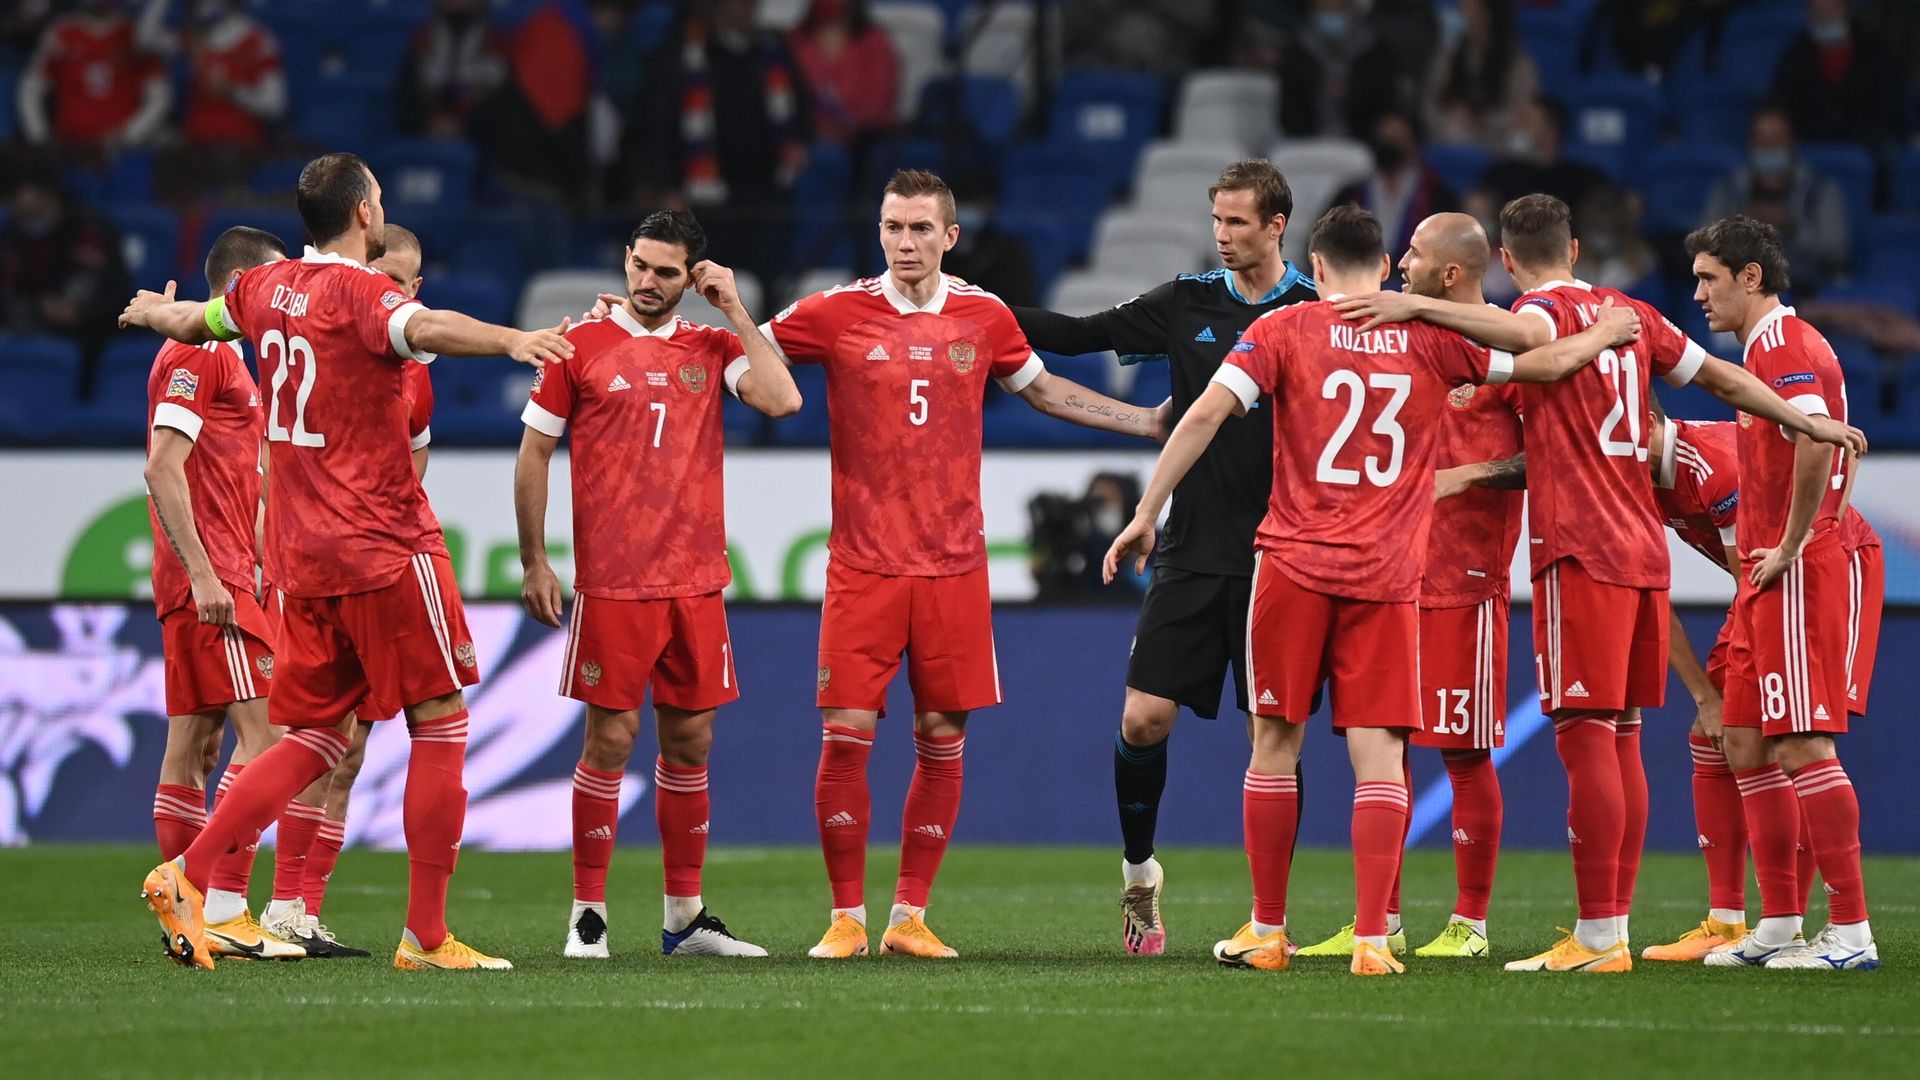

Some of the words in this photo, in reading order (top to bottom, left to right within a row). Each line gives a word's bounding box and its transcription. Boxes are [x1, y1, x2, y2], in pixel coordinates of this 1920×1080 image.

[1330, 324, 1408, 354] KUZIAEV
[260, 329, 326, 447] 22
[1784, 373, 1814, 384] RESPECT
[650, 402, 666, 448] 7
[909, 379, 930, 426] 5
[1599, 348, 1648, 462] 21
[1316, 369, 1412, 488] 23
[1718, 491, 1740, 512] RESPEC
[1433, 688, 1470, 735] 13
